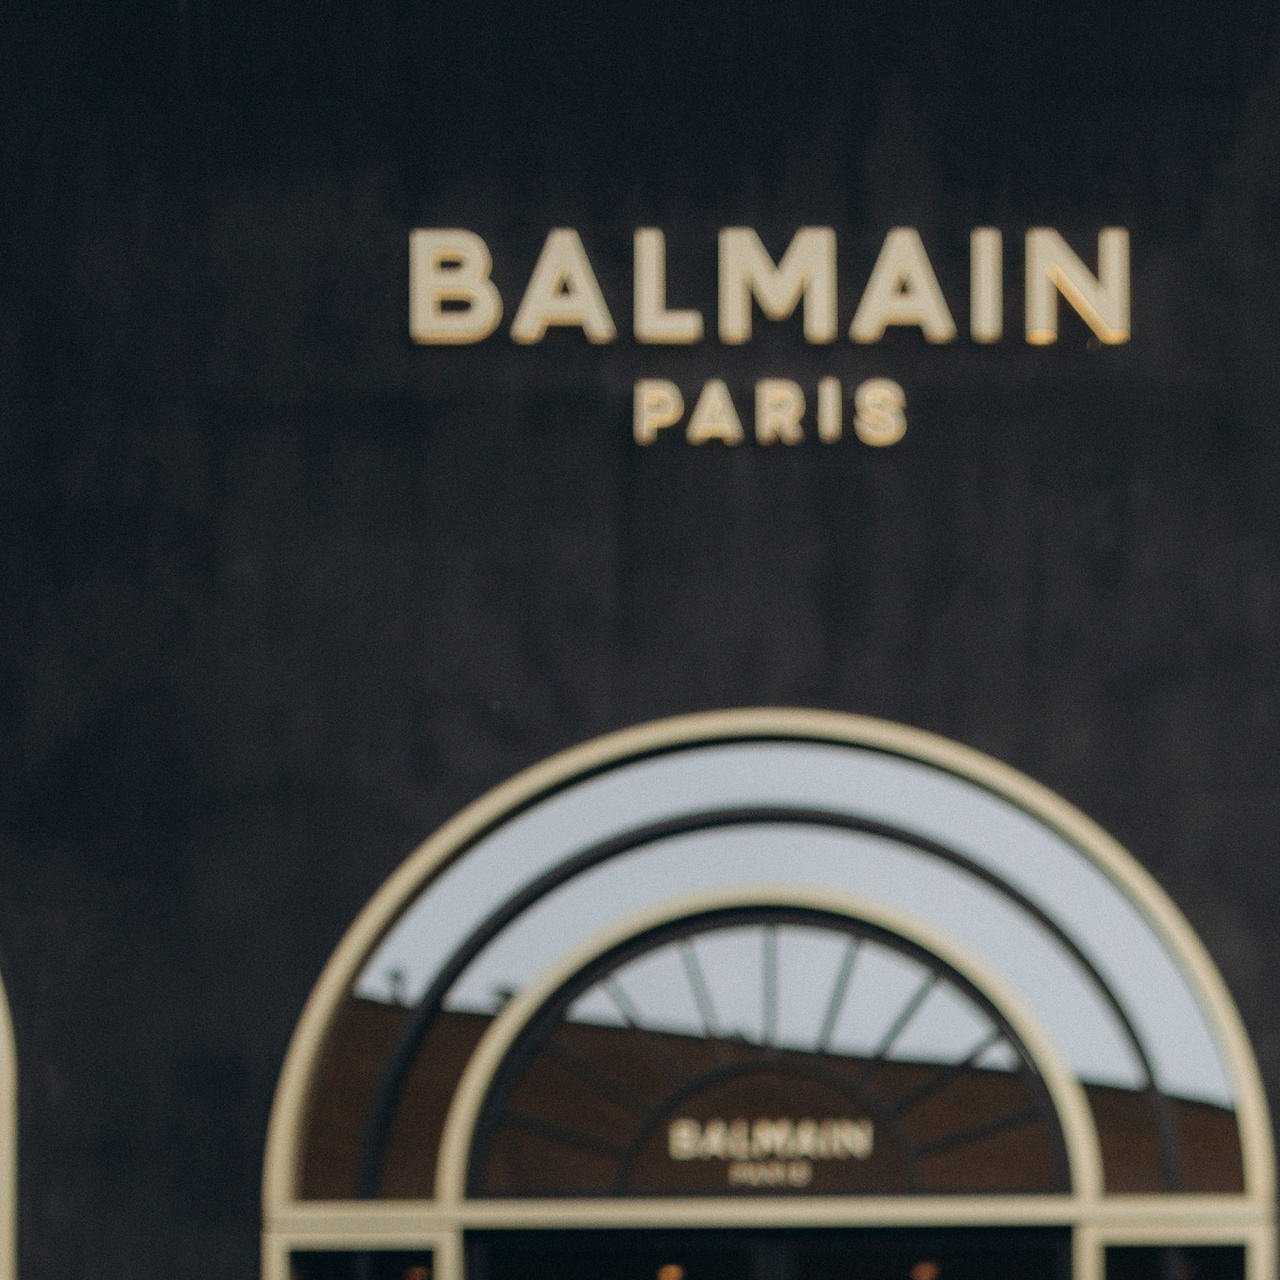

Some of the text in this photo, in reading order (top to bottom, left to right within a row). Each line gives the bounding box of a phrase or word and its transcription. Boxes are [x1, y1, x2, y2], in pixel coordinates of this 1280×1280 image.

[409, 226, 1131, 345] BALMAIN
[633, 376, 907, 446] PARIS
[668, 1118, 873, 1159] BALMAIN
